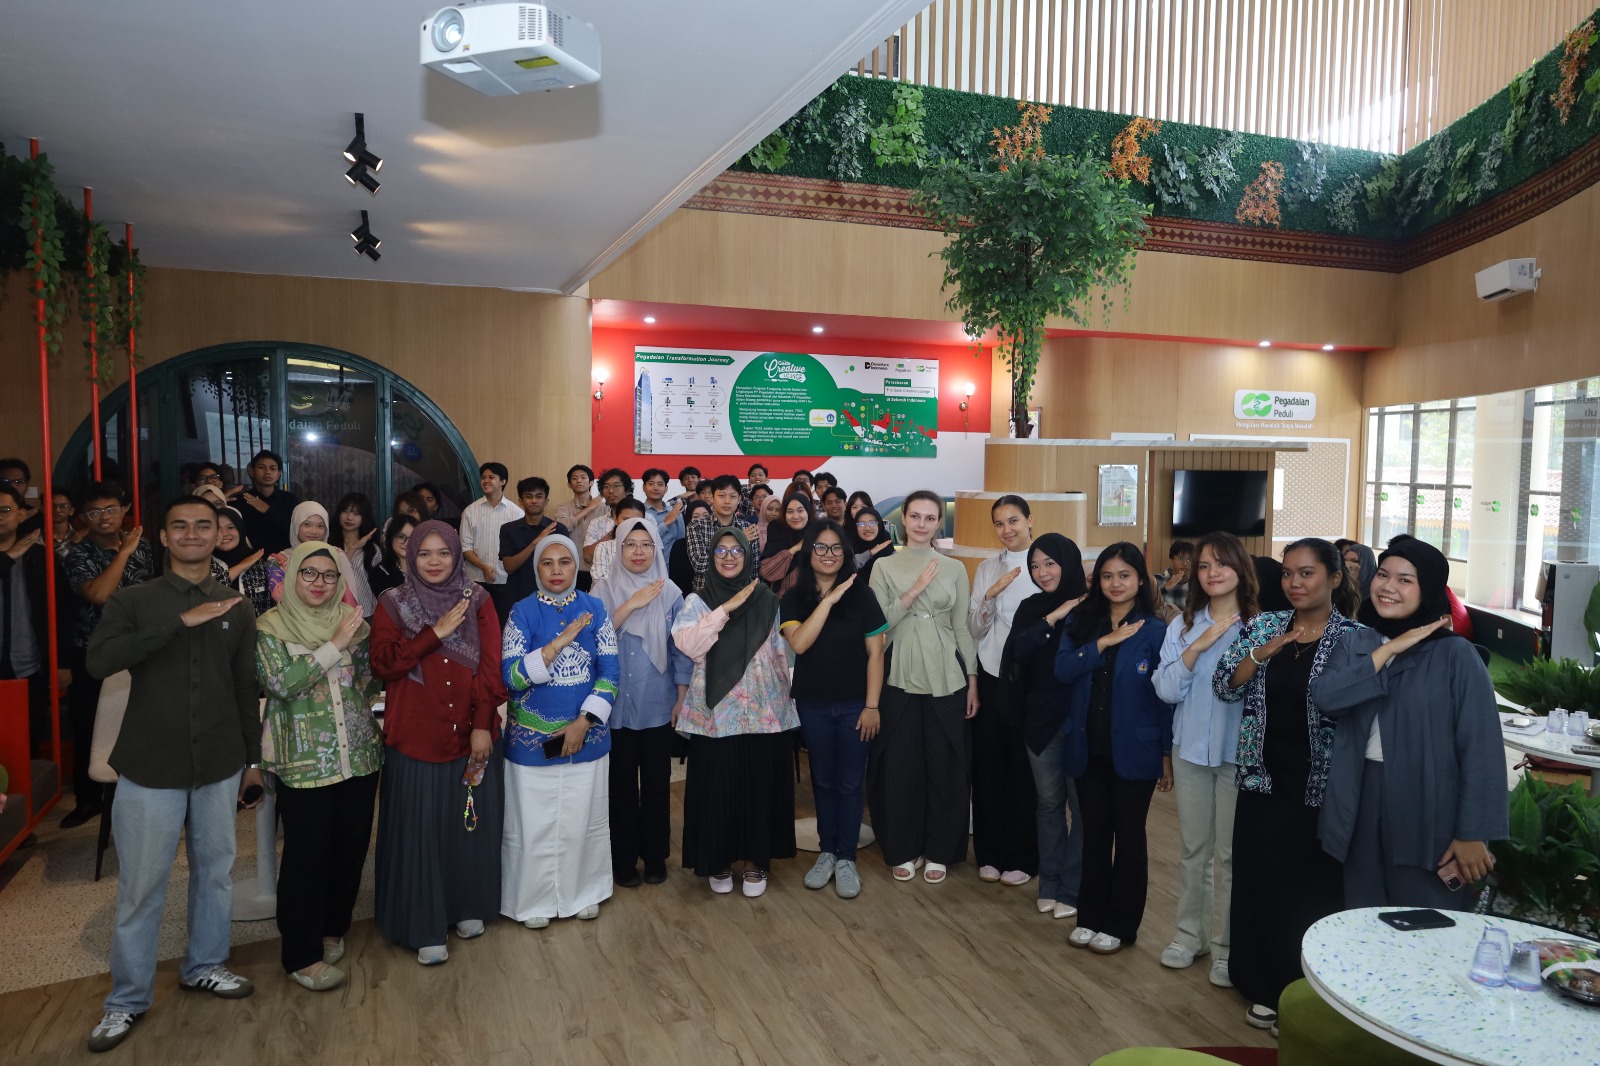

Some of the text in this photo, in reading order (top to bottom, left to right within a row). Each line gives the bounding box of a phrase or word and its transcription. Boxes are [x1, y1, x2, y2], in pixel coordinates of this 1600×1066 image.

[764, 358, 806, 378] Creative
[1274, 396, 1310, 407] Pegadaian
[1274, 410, 1294, 418] Peduli
